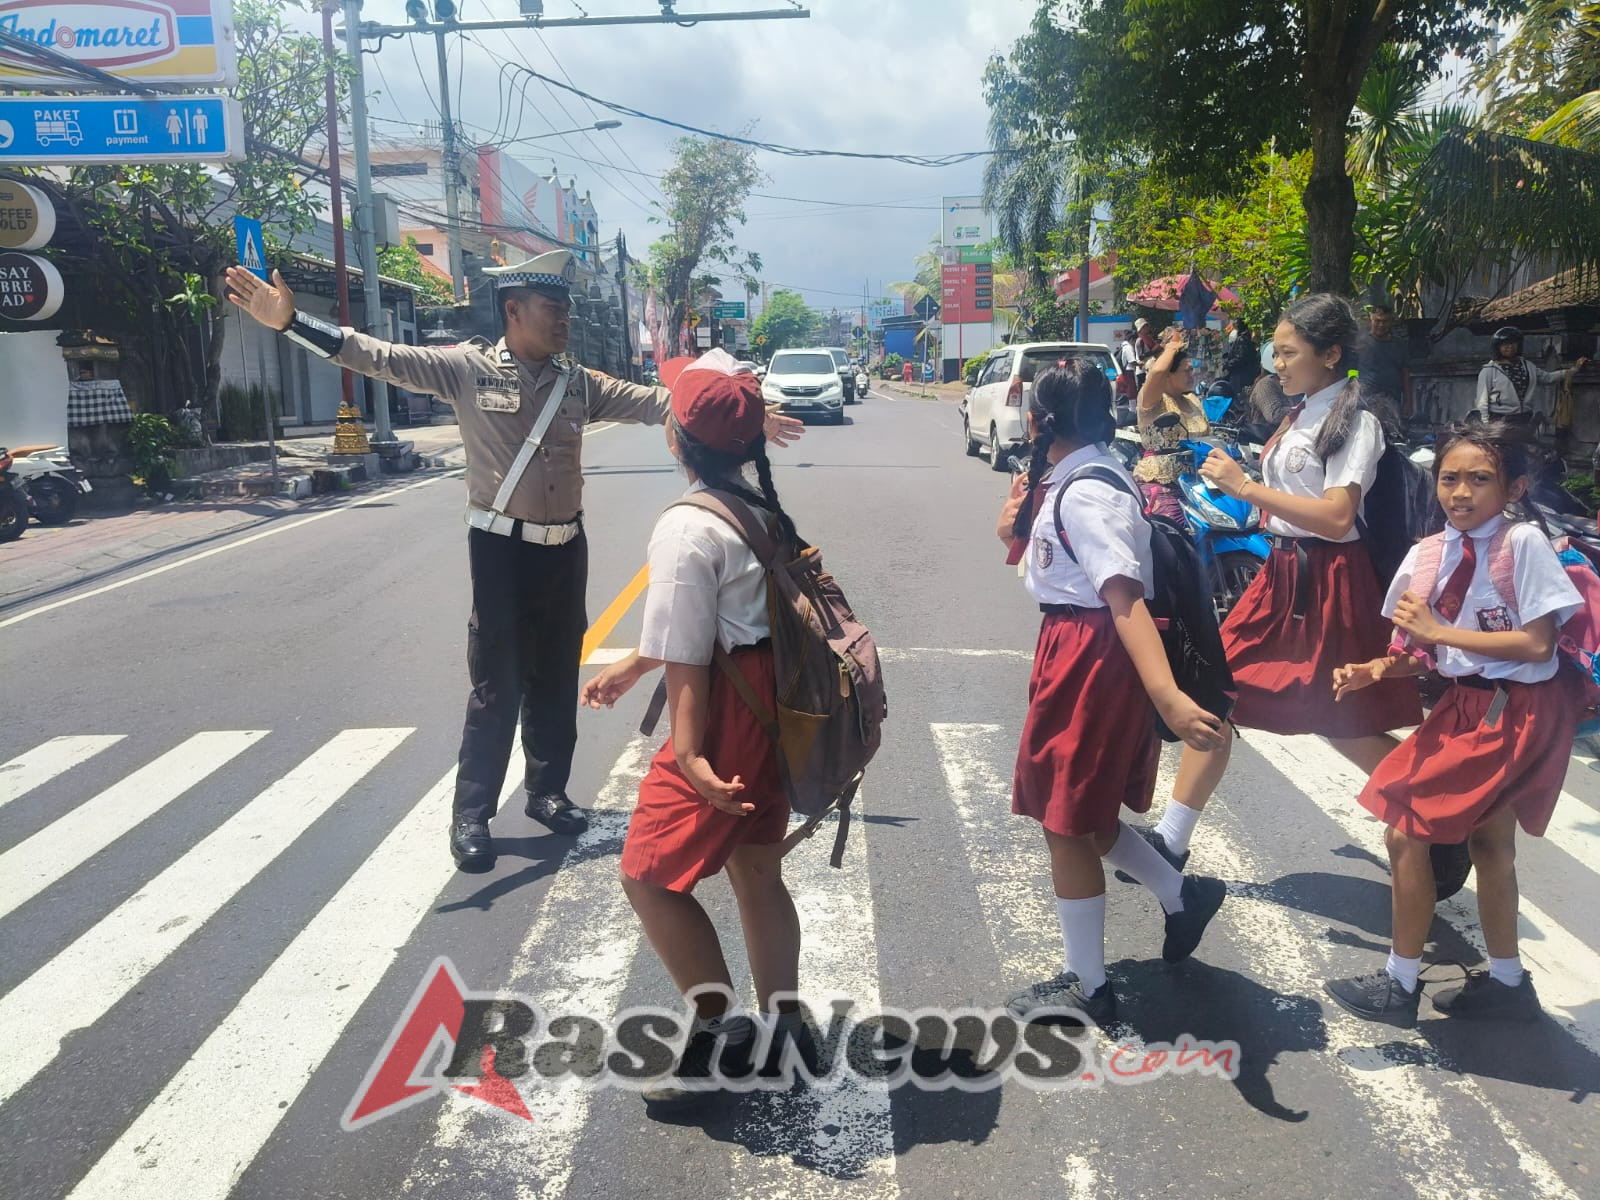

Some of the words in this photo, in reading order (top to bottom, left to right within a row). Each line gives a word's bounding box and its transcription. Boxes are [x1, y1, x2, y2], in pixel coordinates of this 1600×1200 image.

[0, 14, 162, 48] Indomaret
[34, 109, 80, 121] PAKET
[106, 135, 149, 147] payment
[0, 208, 33, 220] FFEE
[0, 219, 28, 231] OLD
[0, 266, 30, 279] SAY
[1, 280, 33, 293] BRE
[2, 294, 25, 307] AD
